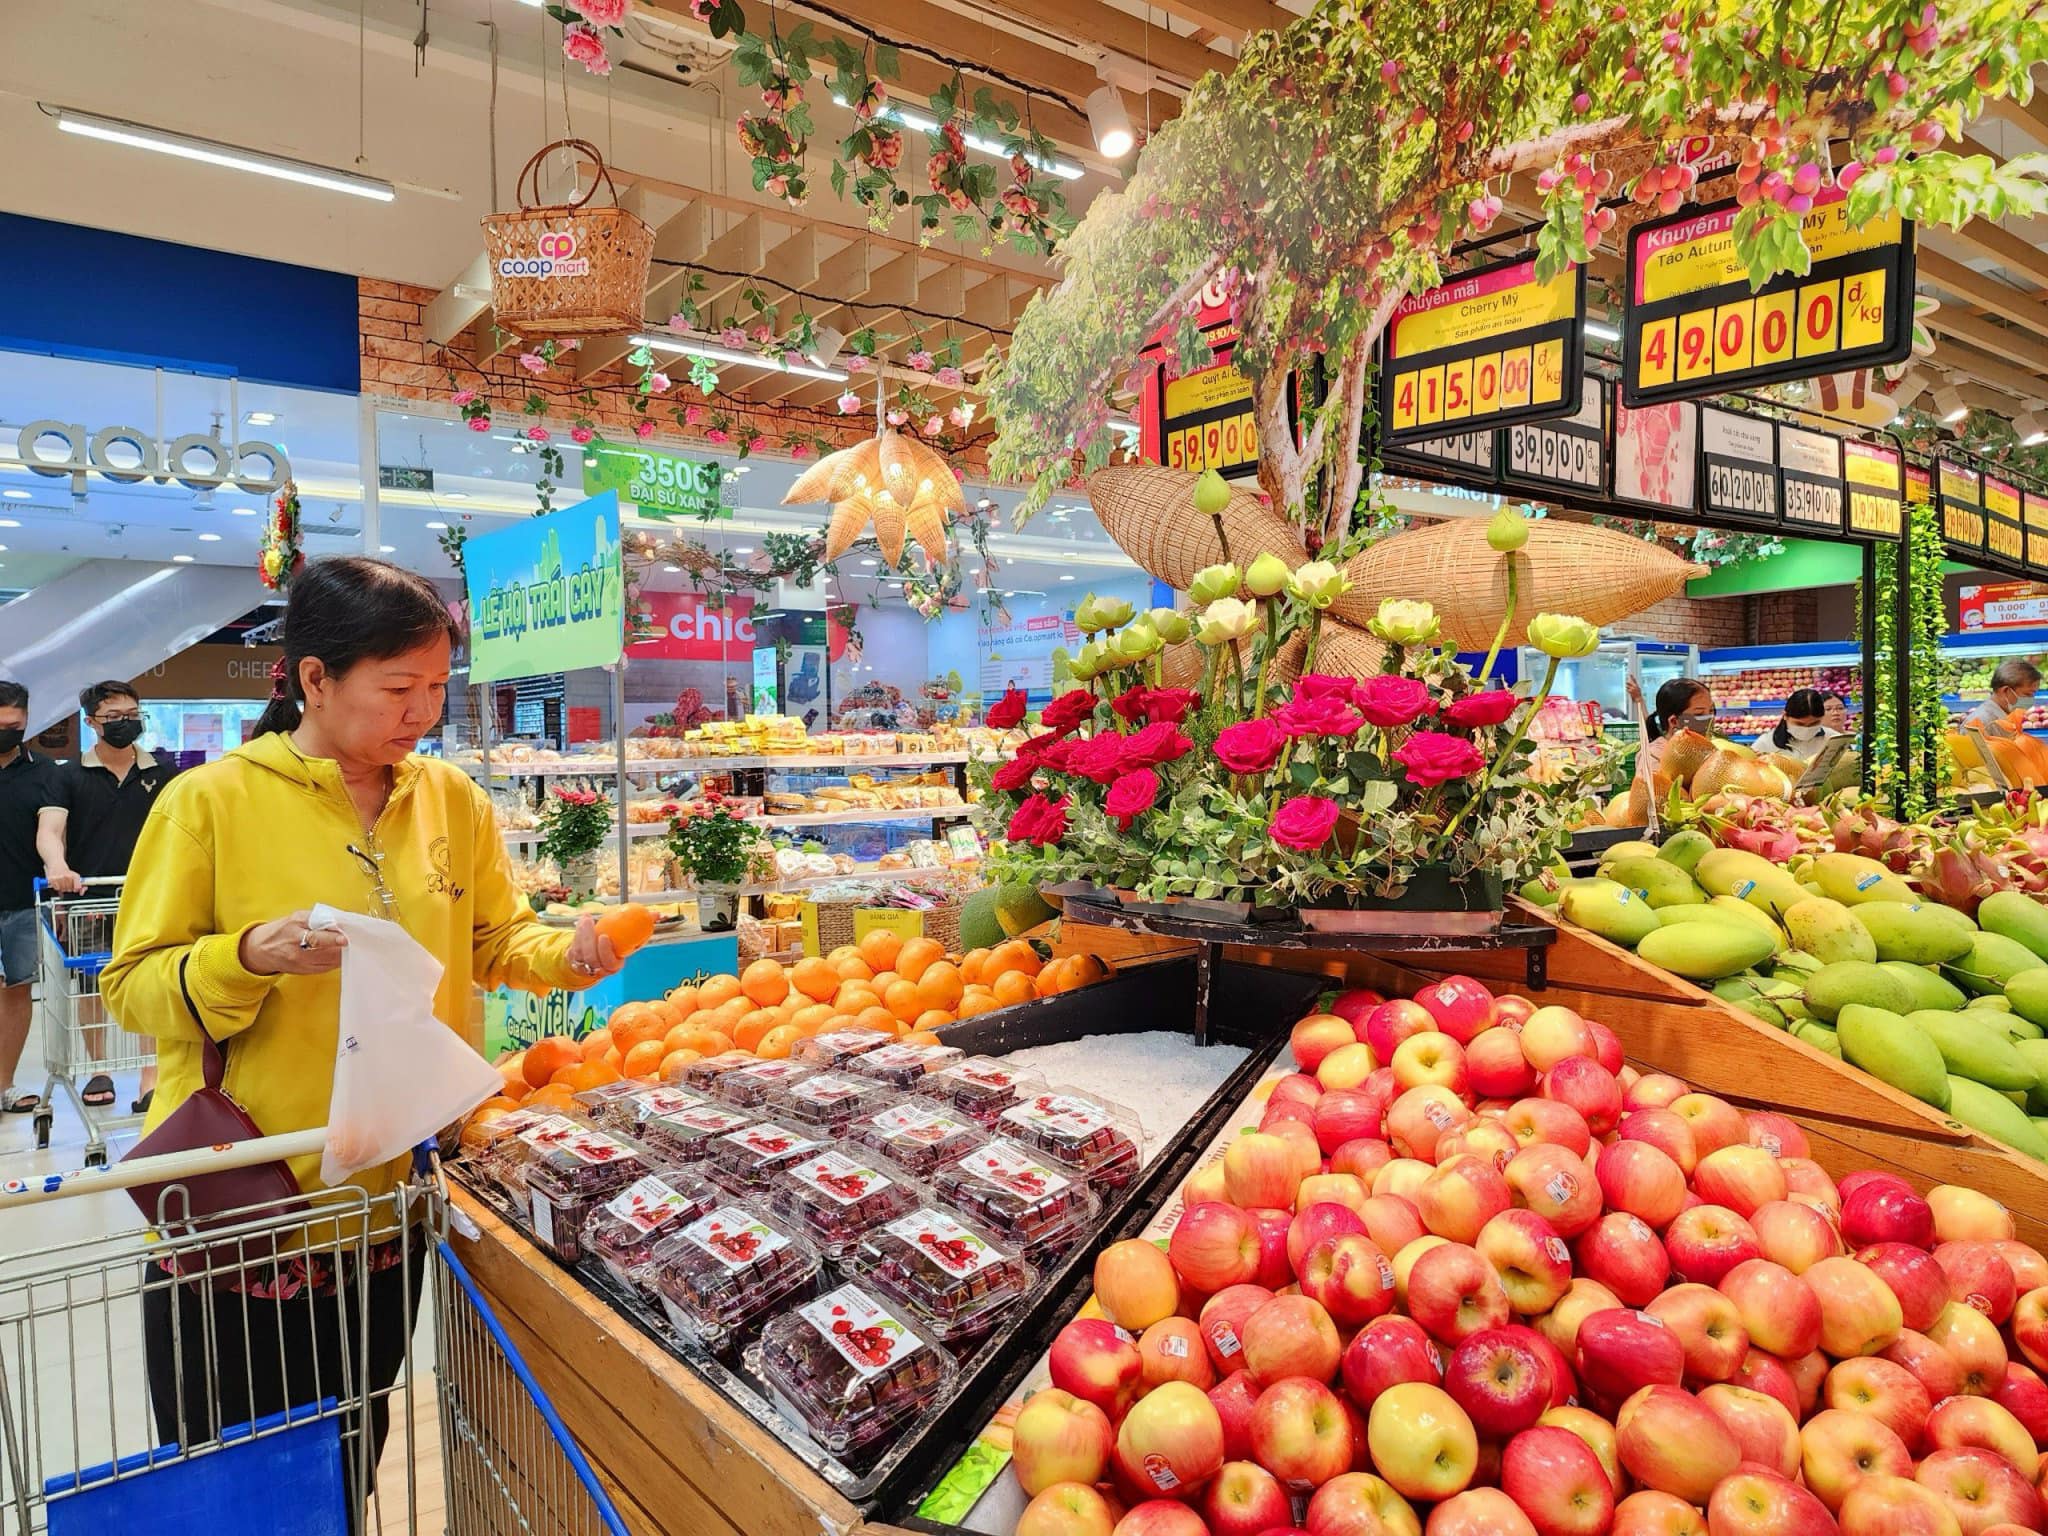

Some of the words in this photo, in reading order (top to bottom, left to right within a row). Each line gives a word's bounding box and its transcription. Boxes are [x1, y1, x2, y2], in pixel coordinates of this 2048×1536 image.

[1453, 279, 1479, 299] mãi
[1460, 298, 1499, 317] Cherry
[1502, 291, 1519, 307] Mỹ
[1645, 294, 1833, 370] 49.000
[1173, 422, 1257, 469] 59.900
[1514, 430, 1584, 472] 39.900
[630, 483, 654, 505] ĐẠI
[680, 494, 707, 510] XAN
[1711, 471, 1763, 504] 60.200
[1788, 486, 1831, 513] 35.900
[502, 581, 527, 642] HỘI
[528, 564, 567, 630] TRÁI
[570, 562, 604, 623] CÂY
[227, 660, 273, 679] CHEE
